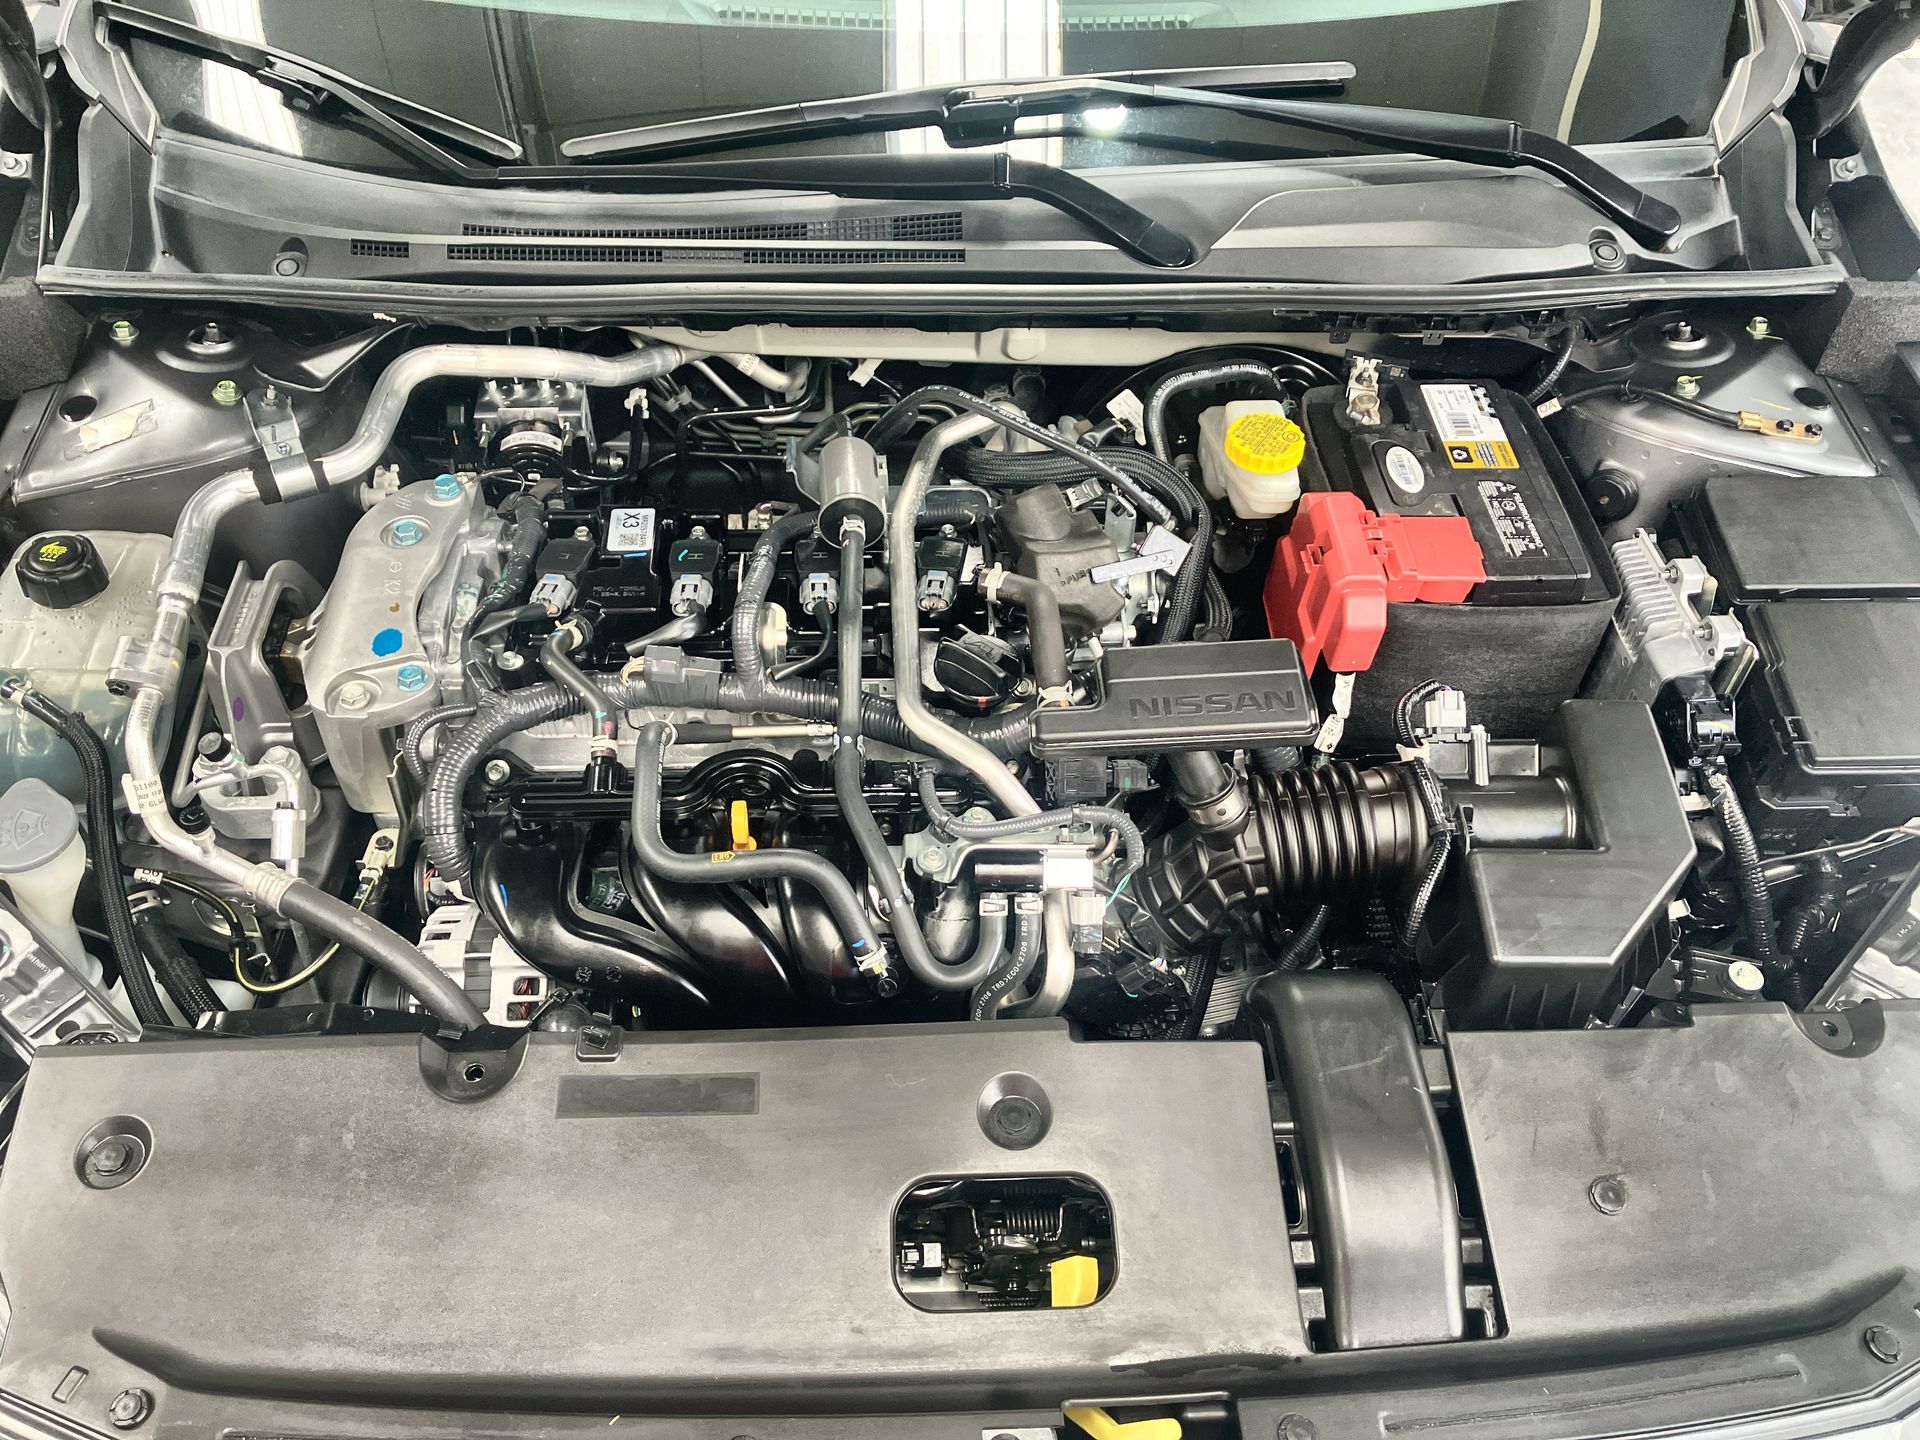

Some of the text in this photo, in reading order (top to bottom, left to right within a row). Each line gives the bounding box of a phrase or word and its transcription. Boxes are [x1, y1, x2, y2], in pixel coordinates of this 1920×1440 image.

[623, 512, 641, 529] X3
[1513, 492, 1544, 547] PELIGRO/VENENO
[1129, 689, 1297, 719] NISSAN
